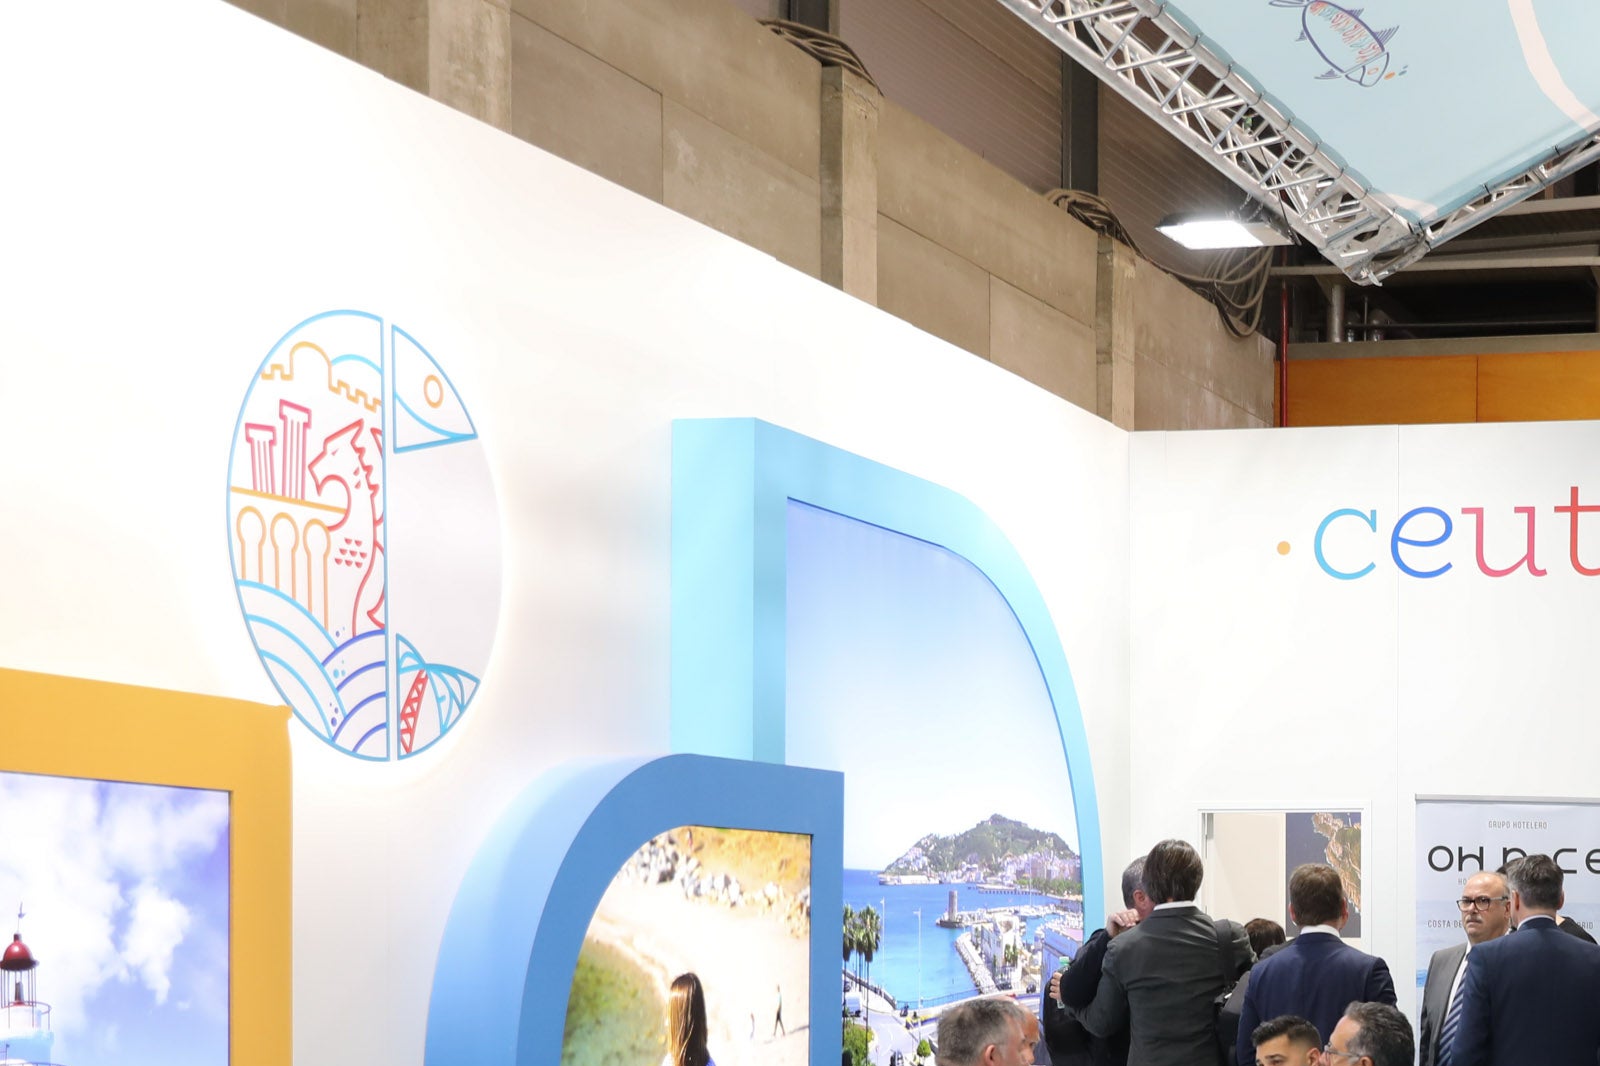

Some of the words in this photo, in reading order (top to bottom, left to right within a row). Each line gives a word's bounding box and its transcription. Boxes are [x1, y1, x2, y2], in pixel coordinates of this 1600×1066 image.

[1488, 820, 1511, 829] GRUPO
[1512, 820, 1548, 830] HOTELERO
[1427, 845, 1484, 872] OH
[1427, 919, 1451, 928] COSTA
